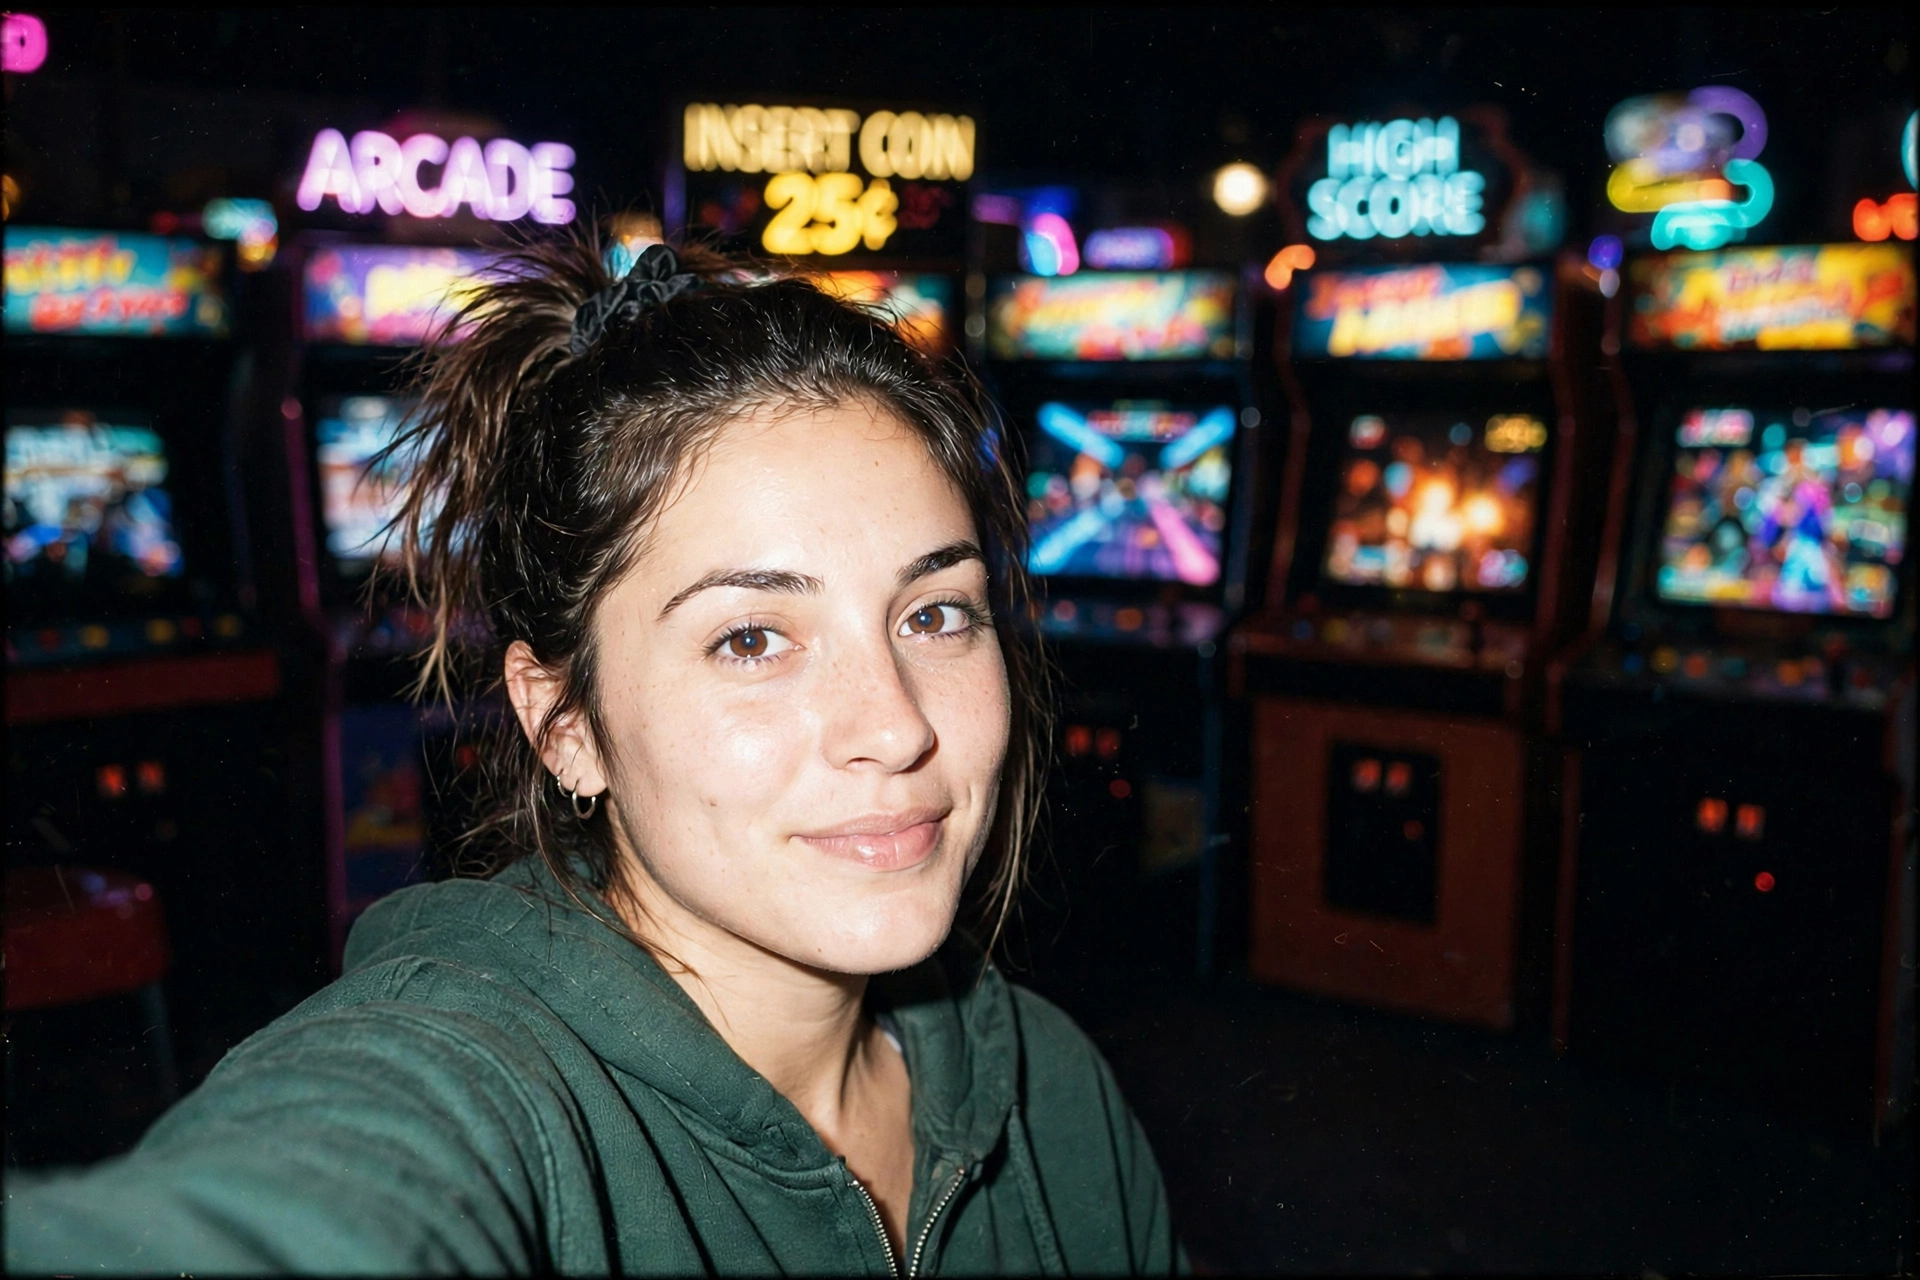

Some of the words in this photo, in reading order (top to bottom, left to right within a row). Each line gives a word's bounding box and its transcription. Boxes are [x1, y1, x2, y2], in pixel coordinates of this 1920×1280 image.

[296, 128, 577, 225] ARCADE
[684, 103, 861, 175] INSERT
[859, 111, 976, 181] COIN
[1328, 116, 1460, 181] HIGH
[762, 171, 899, 256] 25¢
[1307, 171, 1486, 241] SCORE
